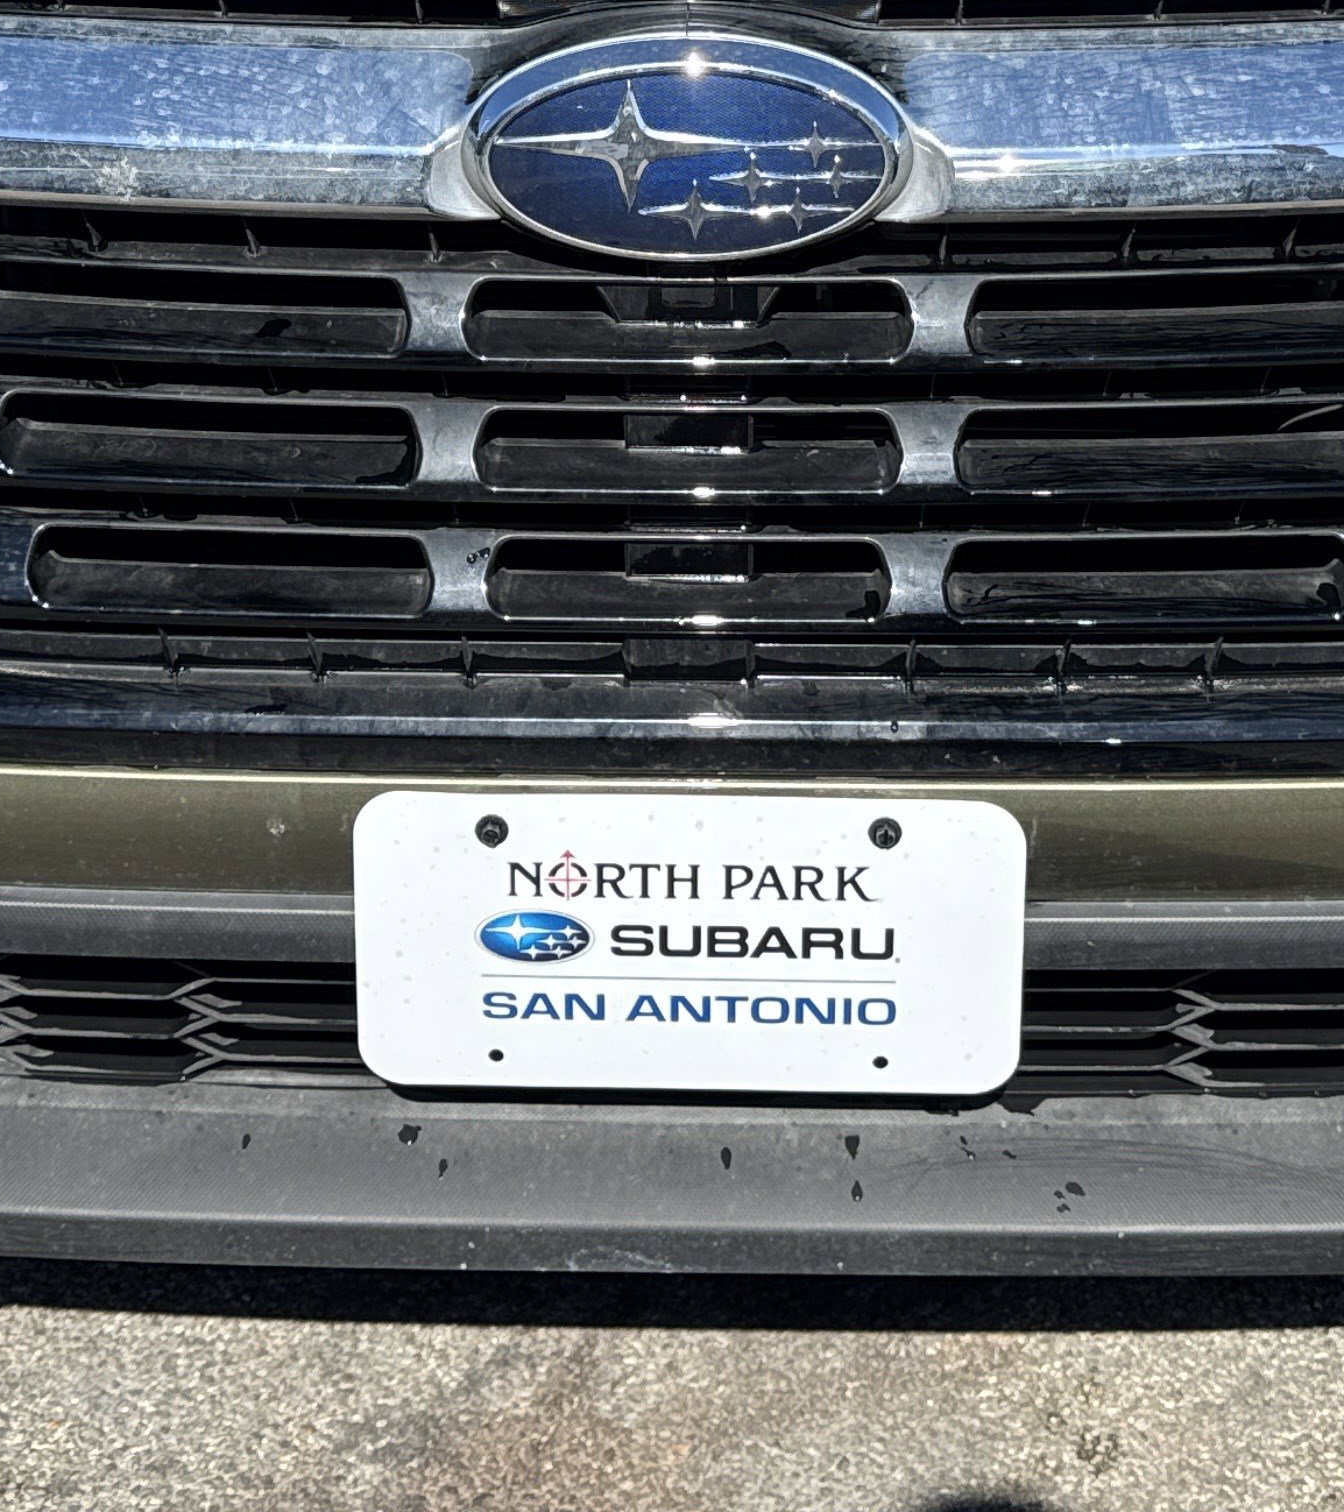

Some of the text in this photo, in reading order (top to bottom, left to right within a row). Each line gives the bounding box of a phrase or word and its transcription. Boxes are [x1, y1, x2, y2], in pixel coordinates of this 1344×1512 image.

[507, 853, 882, 902] NORTH PARK
[610, 924, 897, 963] SUBARU
[482, 991, 897, 1026] SAN ANTONIO
